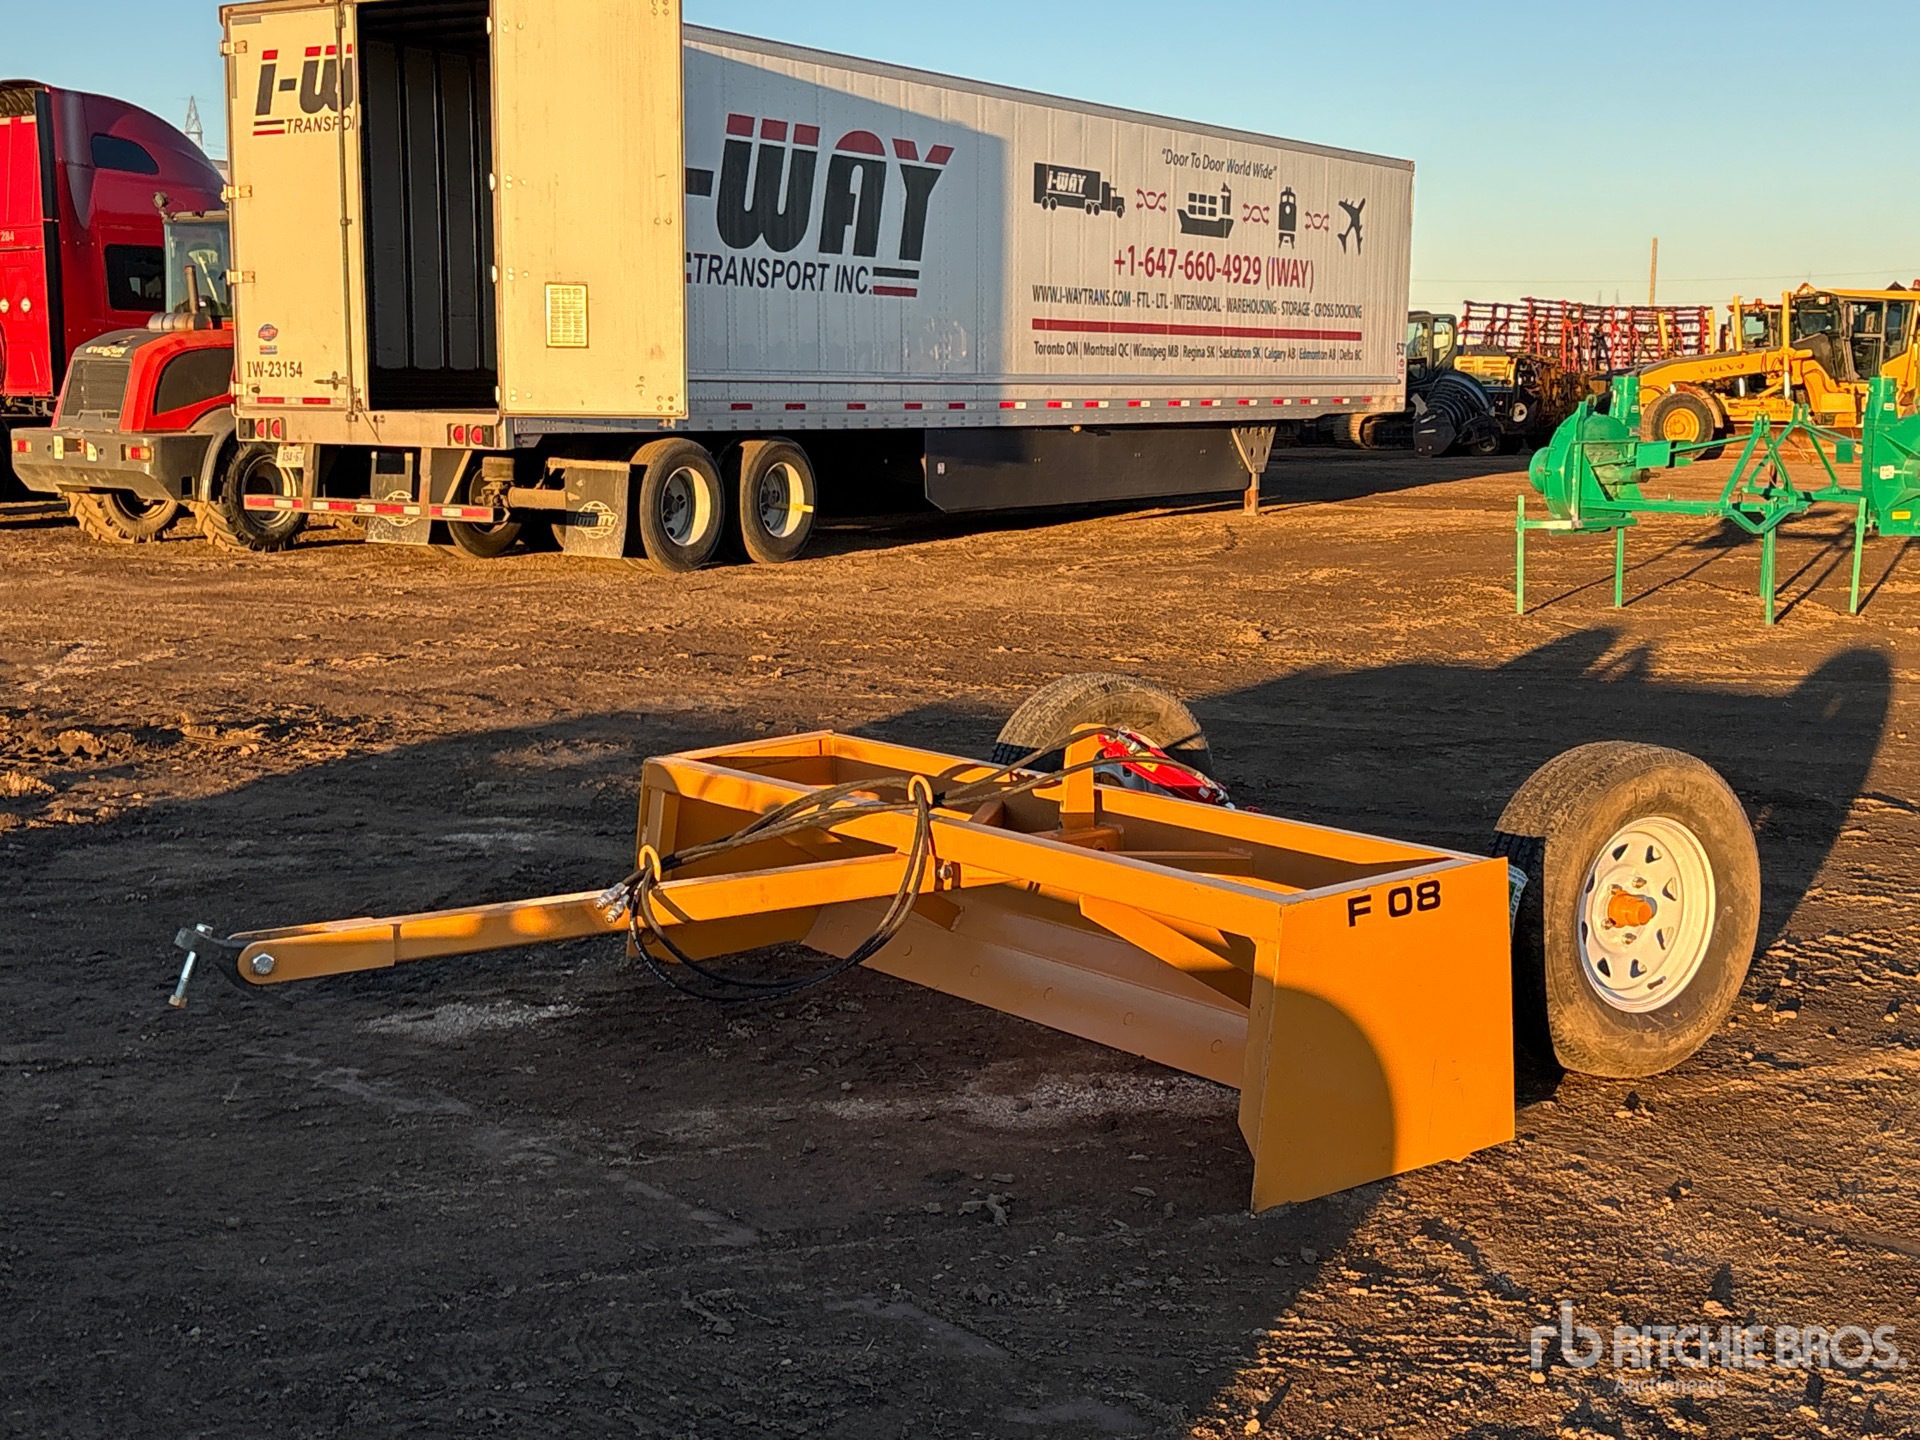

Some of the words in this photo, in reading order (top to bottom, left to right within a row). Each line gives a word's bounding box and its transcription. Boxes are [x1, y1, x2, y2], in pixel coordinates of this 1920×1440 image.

[1190, 152, 1201, 168] To
[1203, 153, 1225, 172] Door
[1227, 158, 1251, 176] World
[693, 252, 830, 292] TRANSPORT
[834, 265, 873, 295] INC.
[1114, 245, 1262, 286] +1-647-660-4929
[1265, 256, 1315, 294] (IWAY)
[1032, 284, 1131, 308] WWW.I-WAYTRANS.COM
[1137, 291, 1151, 309] FTL
[1156, 293, 1169, 310] LTL
[1173, 294, 1222, 313] INTERMODAL
[1226, 297, 1277, 316] WAREHOUSING
[1281, 300, 1310, 317] STORAGE
[1335, 304, 1363, 320] DOCKING
[246, 361, 303, 378] IW-23154
[1034, 340, 1065, 356] Toronto
[1066, 341, 1079, 357] ON
[1083, 342, 1117, 357] Montreal
[1118, 342, 1129, 358] QC
[1133, 343, 1167, 361] Winnipeg
[1168, 344, 1179, 358] MB
[1182, 345, 1206, 362] Regina
[1206, 345, 1216, 358] SK
[1219, 345, 1251, 359] Saskatoon
[1253, 346, 1261, 359] SK
[1264, 347, 1286, 363] Calgary
[1339, 348, 1354, 361] Delta
[1347, 894, 1371, 928] F
[1388, 880, 1441, 918] 08
